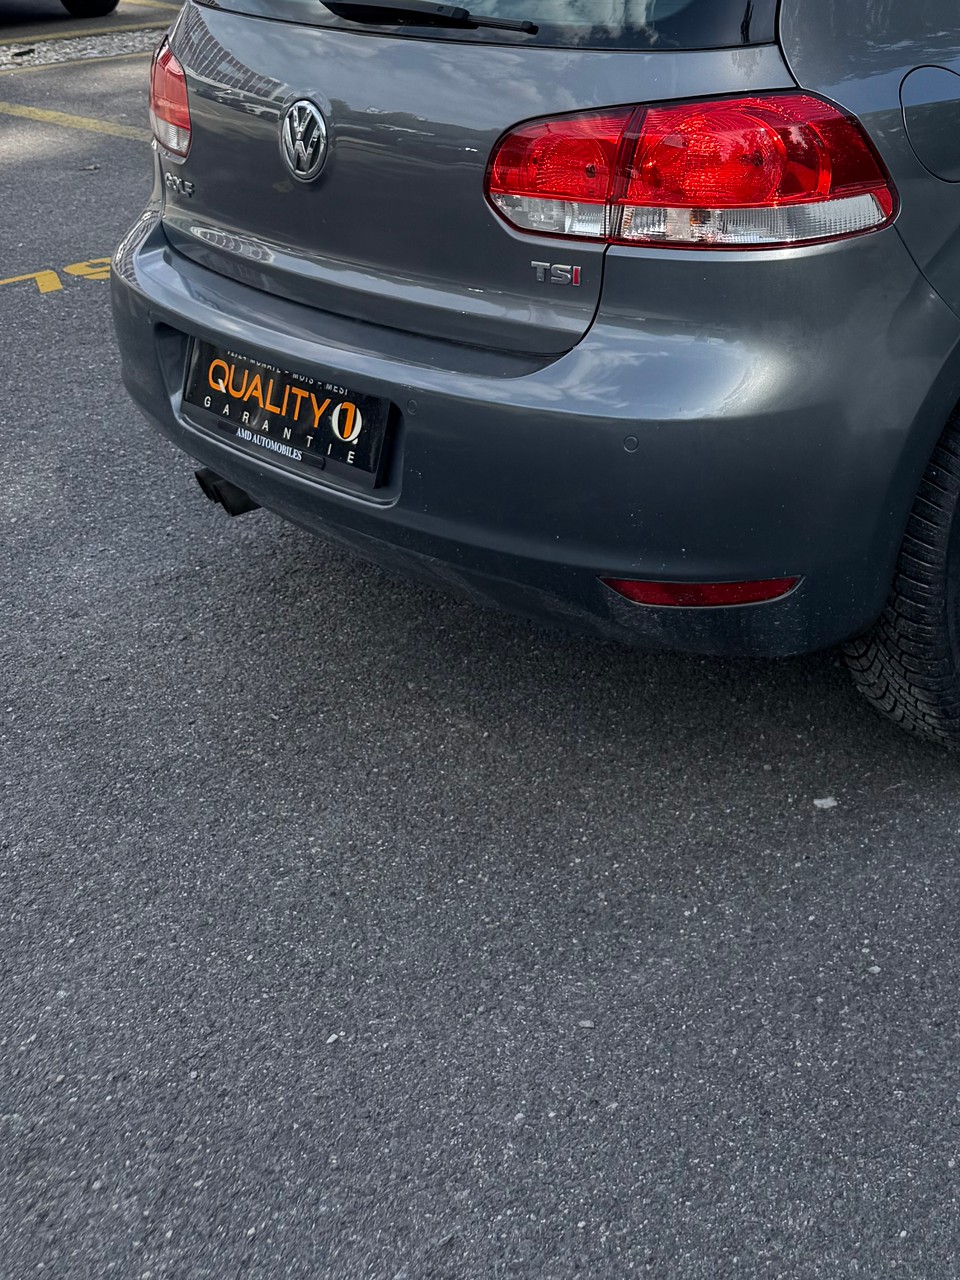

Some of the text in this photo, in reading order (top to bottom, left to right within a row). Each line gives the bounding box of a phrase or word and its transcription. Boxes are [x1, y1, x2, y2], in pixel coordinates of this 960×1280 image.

[531, 261, 581, 286] TSI
[208, 358, 331, 429] QUALITY
[204, 396, 356, 464] GARANTIE
[236, 427, 303, 461] AMD AUTOMOBILES
